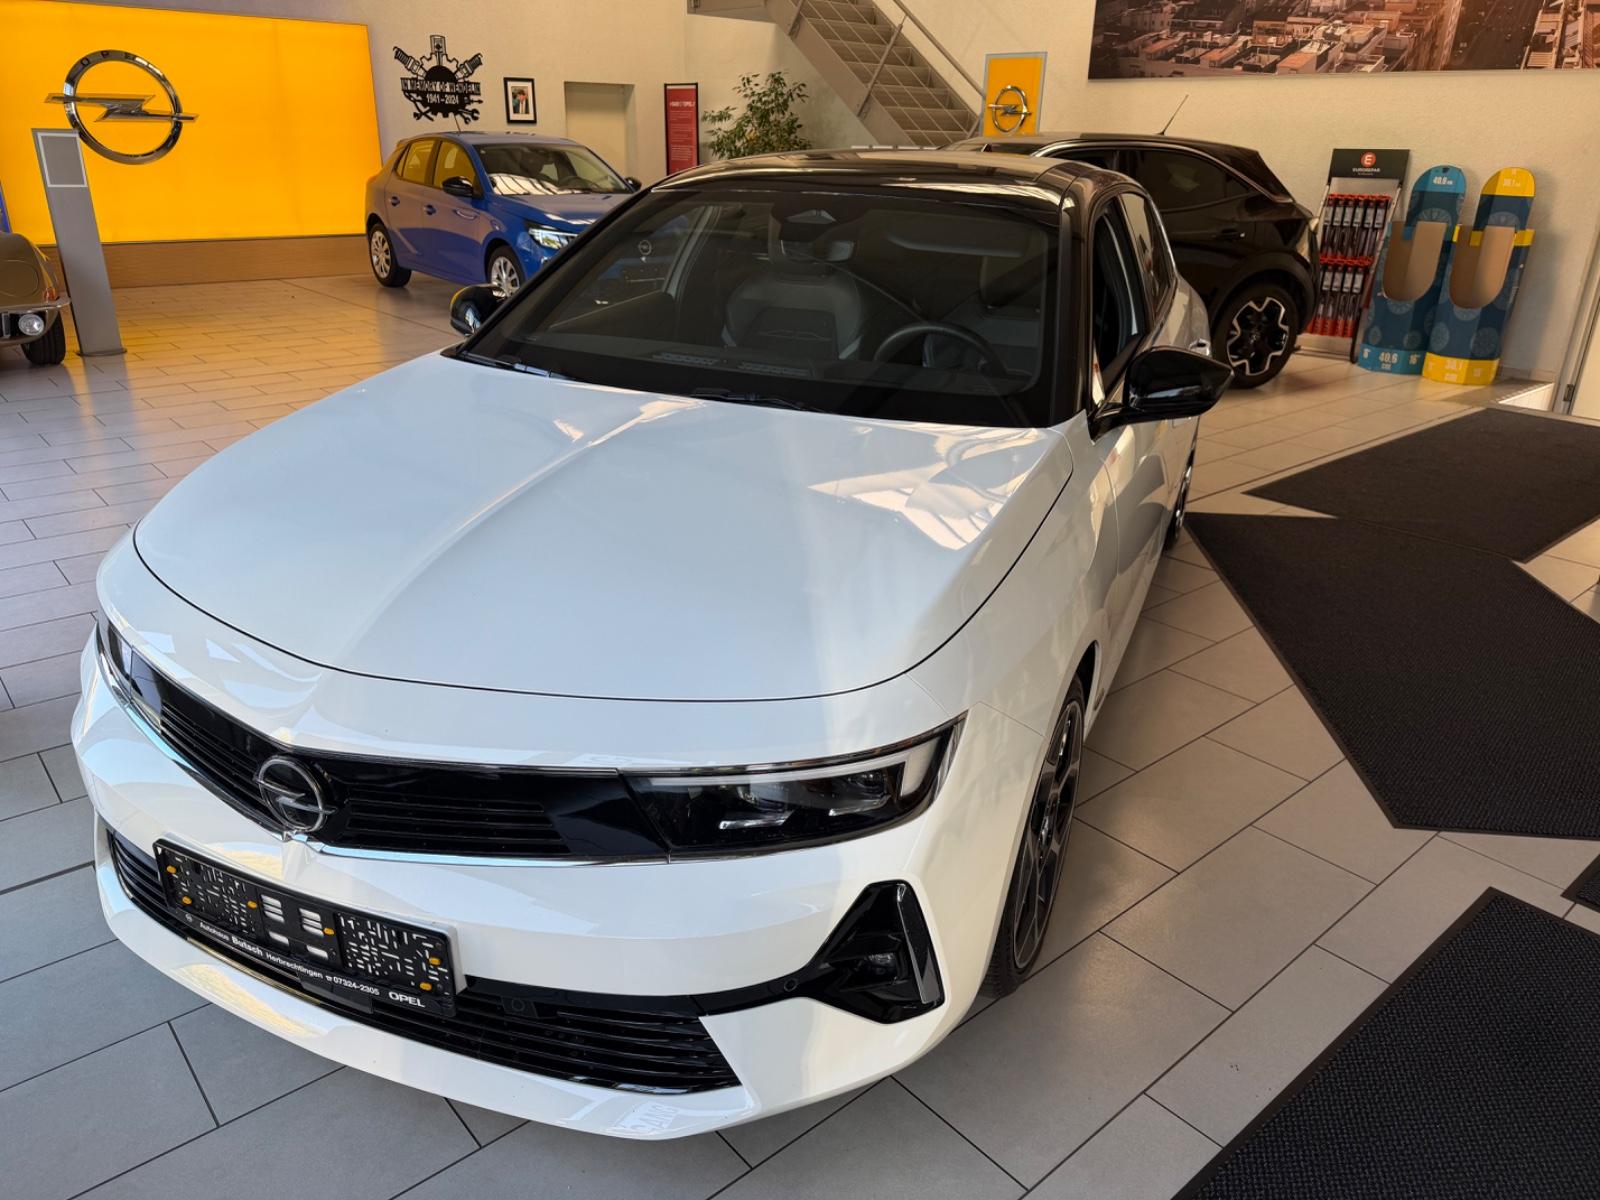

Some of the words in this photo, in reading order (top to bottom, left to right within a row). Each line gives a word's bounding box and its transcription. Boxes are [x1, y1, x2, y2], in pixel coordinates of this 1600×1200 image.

[410, 80, 437, 91] MEMORY
[200, 921, 229, 941] Autohaus
[231, 935, 263, 957] Butsch
[265, 951, 323, 980] Herbrechtingen
[333, 976, 380, 996] 07324-2305
[388, 991, 426, 1008] OPEL
